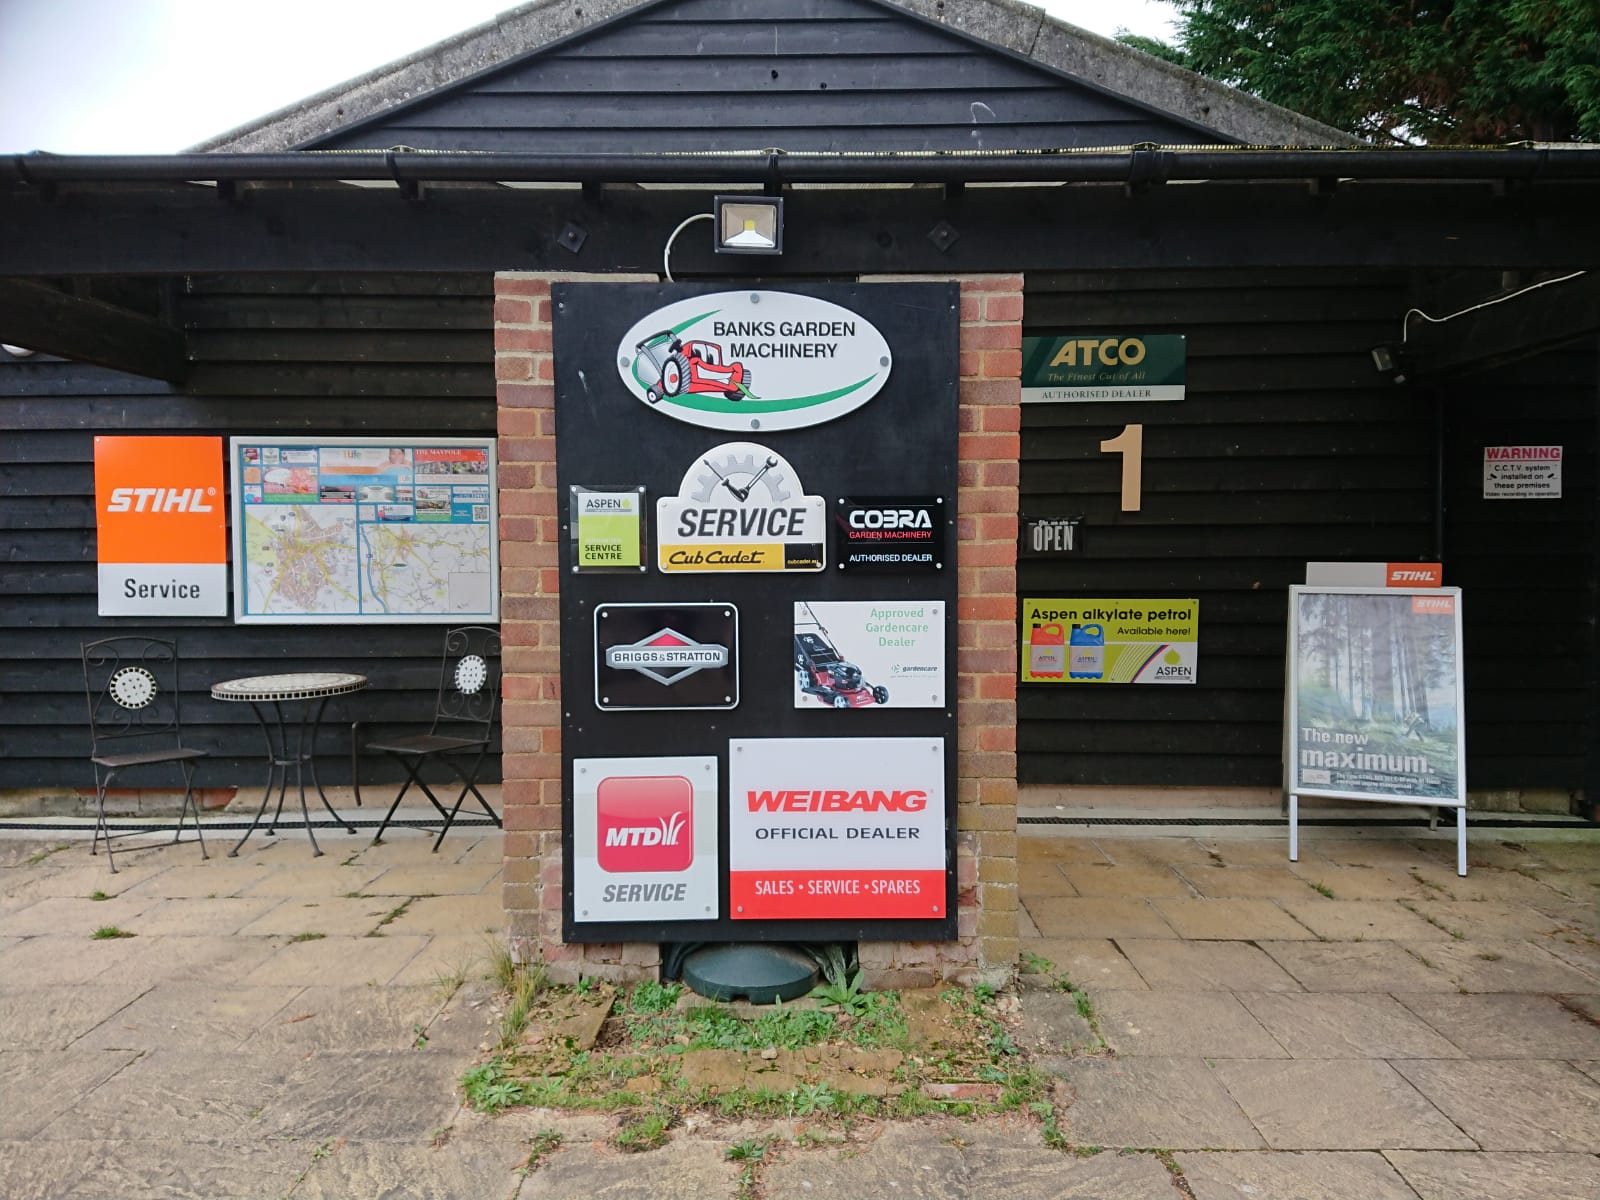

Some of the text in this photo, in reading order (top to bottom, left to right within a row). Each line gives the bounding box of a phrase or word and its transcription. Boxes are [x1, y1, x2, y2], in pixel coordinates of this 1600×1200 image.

[713, 321, 856, 337] BANKS GARDEN
[730, 343, 838, 358] MACHINERY
[1049, 337, 1146, 367] ATCO
[1048, 371, 1146, 382] The Finest Cut of All
[1042, 389, 1152, 399] AUTHORISED DEALER
[1486, 447, 1561, 459] WARNING
[1100, 424, 1143, 511] 1
[1525, 465, 1551, 473] system
[1516, 482, 1551, 490] premises
[586, 499, 621, 508] ASPEN
[677, 508, 807, 537] SERVICE
[849, 509, 932, 529] COBRA
[849, 531, 932, 539] GARDEN MACHINERY
[1033, 525, 1073, 551] OPEN
[585, 544, 622, 552] SERVICE
[585, 552, 623, 560] CENTRE
[669, 550, 765, 565] Cub Cadet
[849, 554, 933, 562] AUTHORISED DEALER
[124, 578, 200, 599] Service
[1417, 599, 1451, 608] STIHL
[870, 607, 924, 620] Approved
[1031, 608, 1192, 622] Aspen alkylate petrol
[865, 622, 929, 633] Gardencare
[1117, 627, 1191, 636] Available here!
[879, 636, 916, 647] Dealer
[902, 665, 938, 673] gardencare
[1156, 667, 1192, 676] ASPEN
[1301, 727, 1369, 745] The new
[1301, 747, 1435, 774] maximum.
[747, 790, 928, 812] WEIBANG
[605, 827, 662, 847] MTD
[755, 827, 920, 840] OFFICIAL DEALER
[602, 883, 687, 903] SERVICE
[755, 879, 921, 895] SALES SERVICE SPARES
